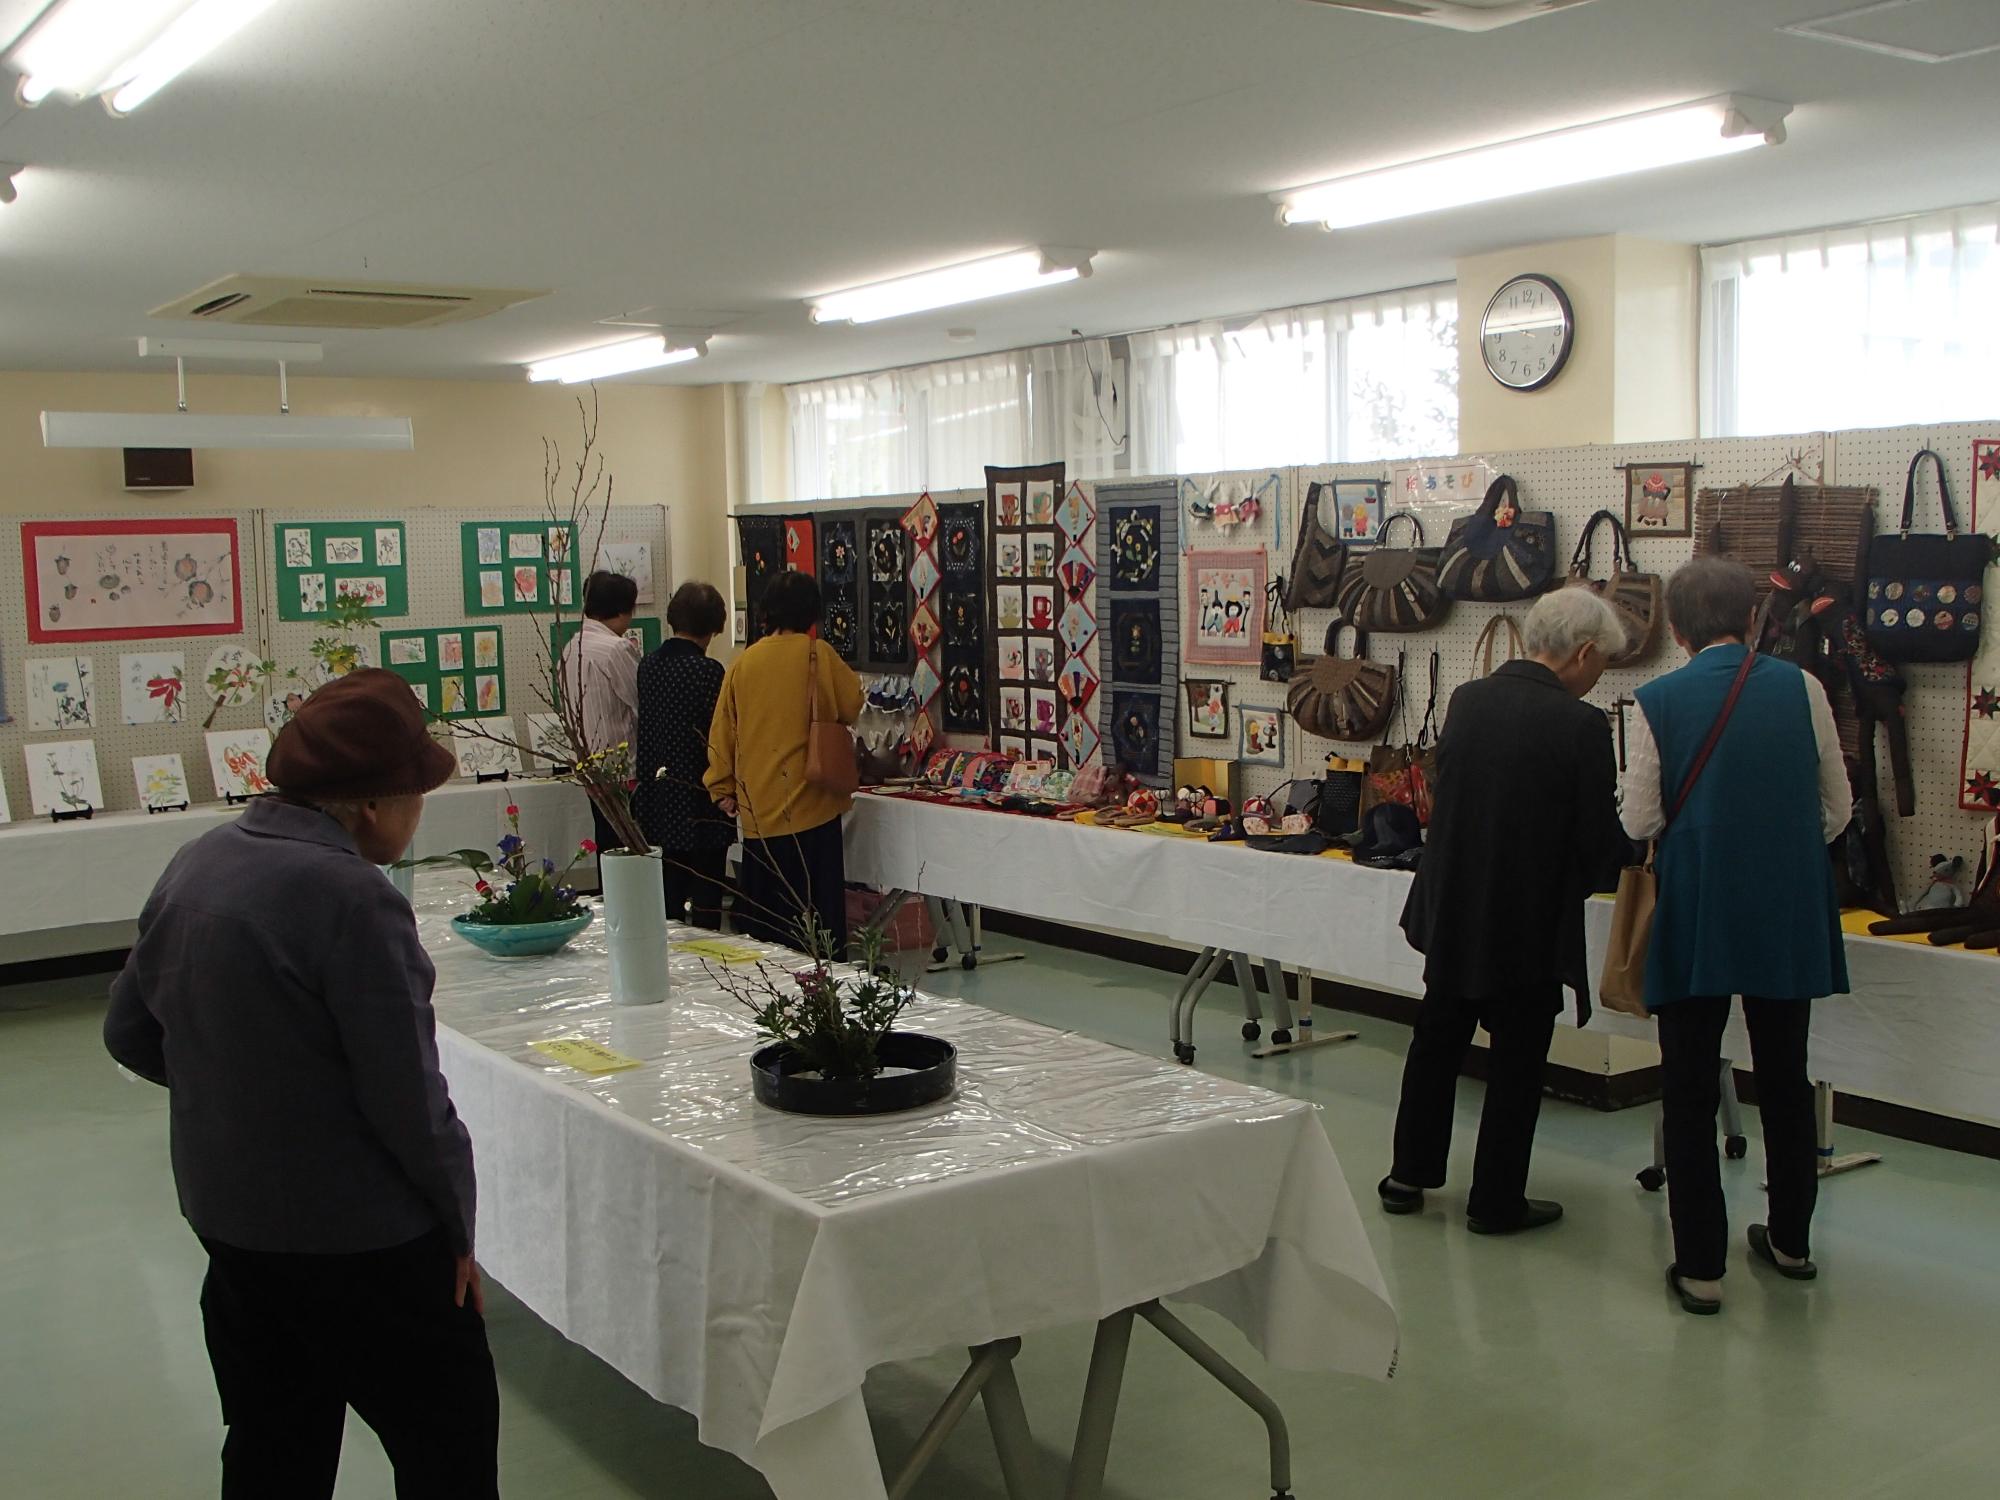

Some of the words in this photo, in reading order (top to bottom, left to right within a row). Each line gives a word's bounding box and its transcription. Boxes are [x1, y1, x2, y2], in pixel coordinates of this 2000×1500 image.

[1509, 296, 1518, 309] 11
[1522, 289, 1533, 303] 12
[1553, 325, 1561, 337] 3
[1494, 333, 1502, 344] 9
[1498, 349, 1506, 362] 8
[1548, 343, 1555, 356] 4
[1510, 360, 1518, 374] 7
[1523, 364, 1531, 377] 6
[1538, 357, 1546, 371] 5
